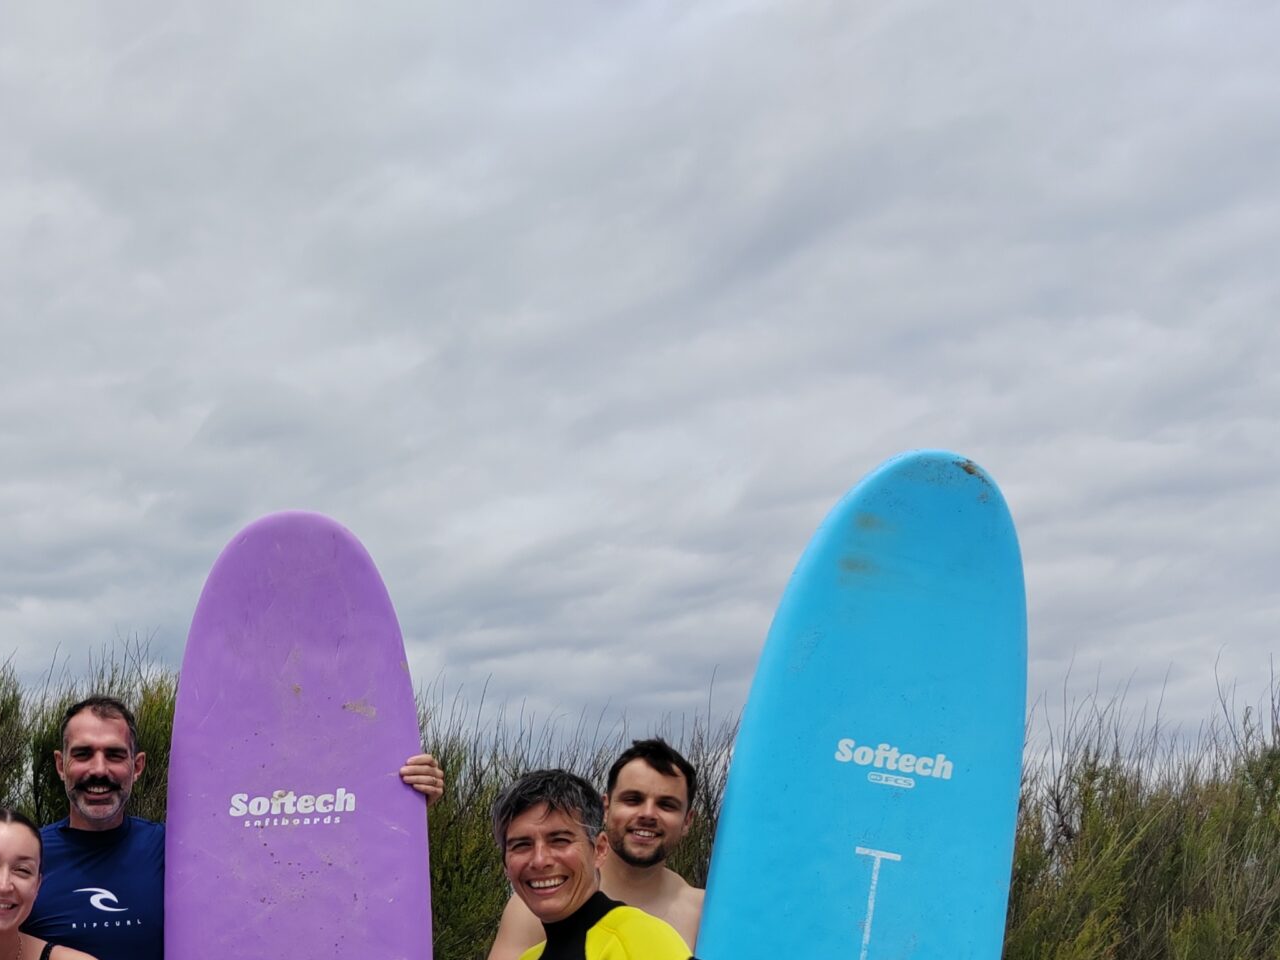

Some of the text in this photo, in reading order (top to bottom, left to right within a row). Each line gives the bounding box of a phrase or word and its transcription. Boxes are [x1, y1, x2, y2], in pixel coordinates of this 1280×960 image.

[834, 738, 954, 780] Softech
[229, 787, 356, 817] Softech
[244, 815, 341, 828] softboards
